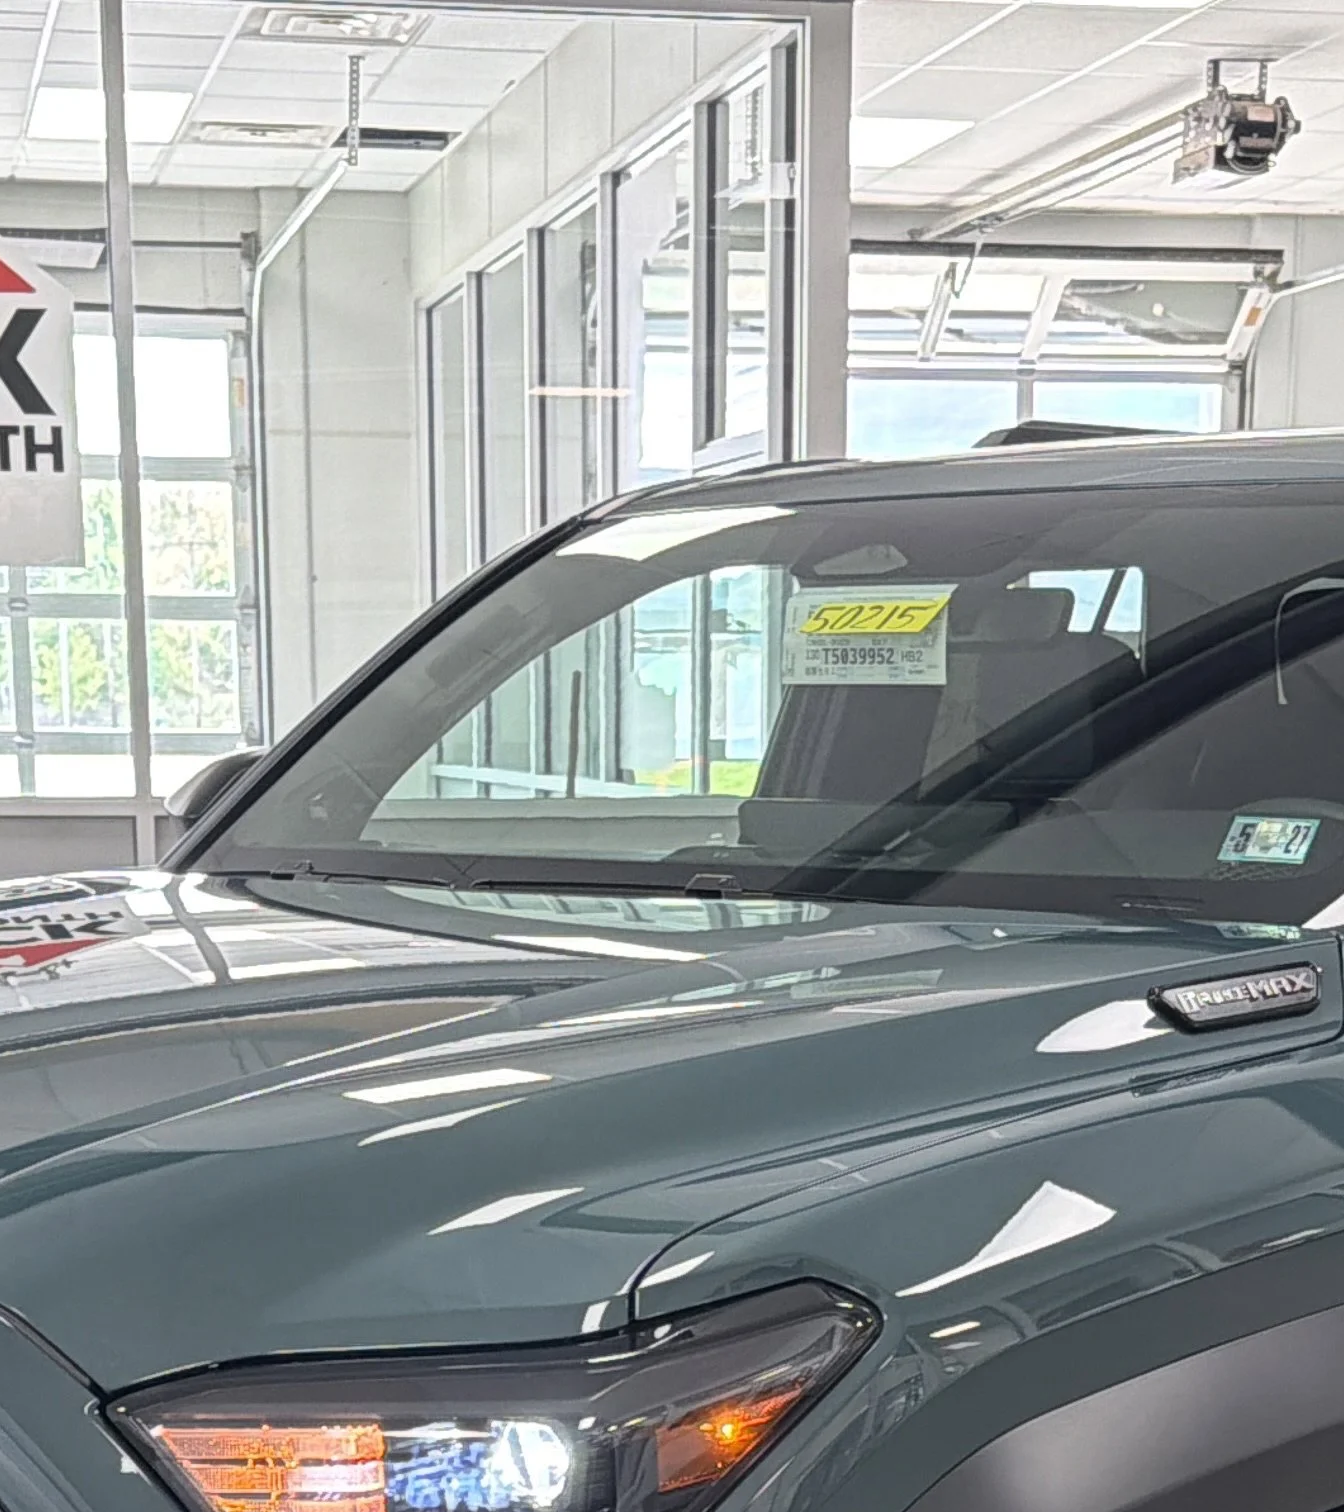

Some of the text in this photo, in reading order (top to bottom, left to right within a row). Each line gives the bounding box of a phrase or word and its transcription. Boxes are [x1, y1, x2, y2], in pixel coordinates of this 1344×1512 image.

[800, 602, 938, 633] 50215
[822, 647, 895, 665] T5039952
[1282, 823, 1312, 855] 27
